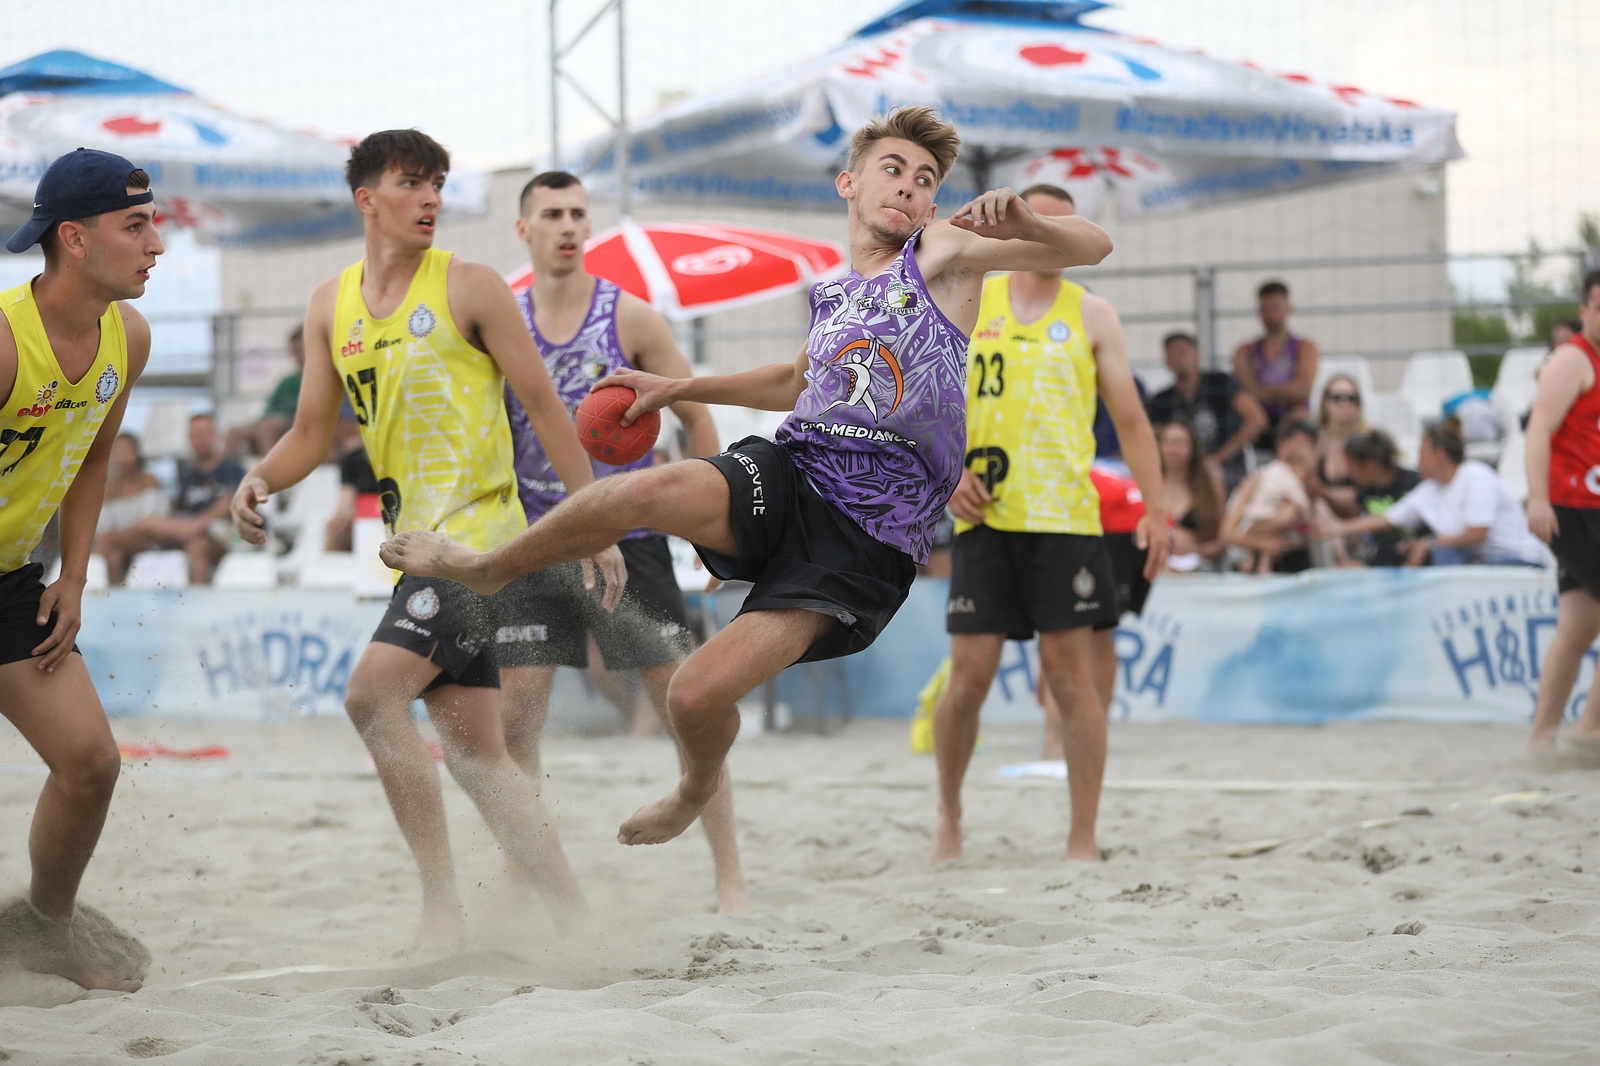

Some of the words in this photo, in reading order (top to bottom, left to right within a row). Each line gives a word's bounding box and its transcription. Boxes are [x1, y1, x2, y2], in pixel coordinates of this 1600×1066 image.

[822, 283, 851, 336] 2
[341, 340, 364, 357] ebt
[346, 366, 378, 427] 37
[976, 352, 1005, 397] 23
